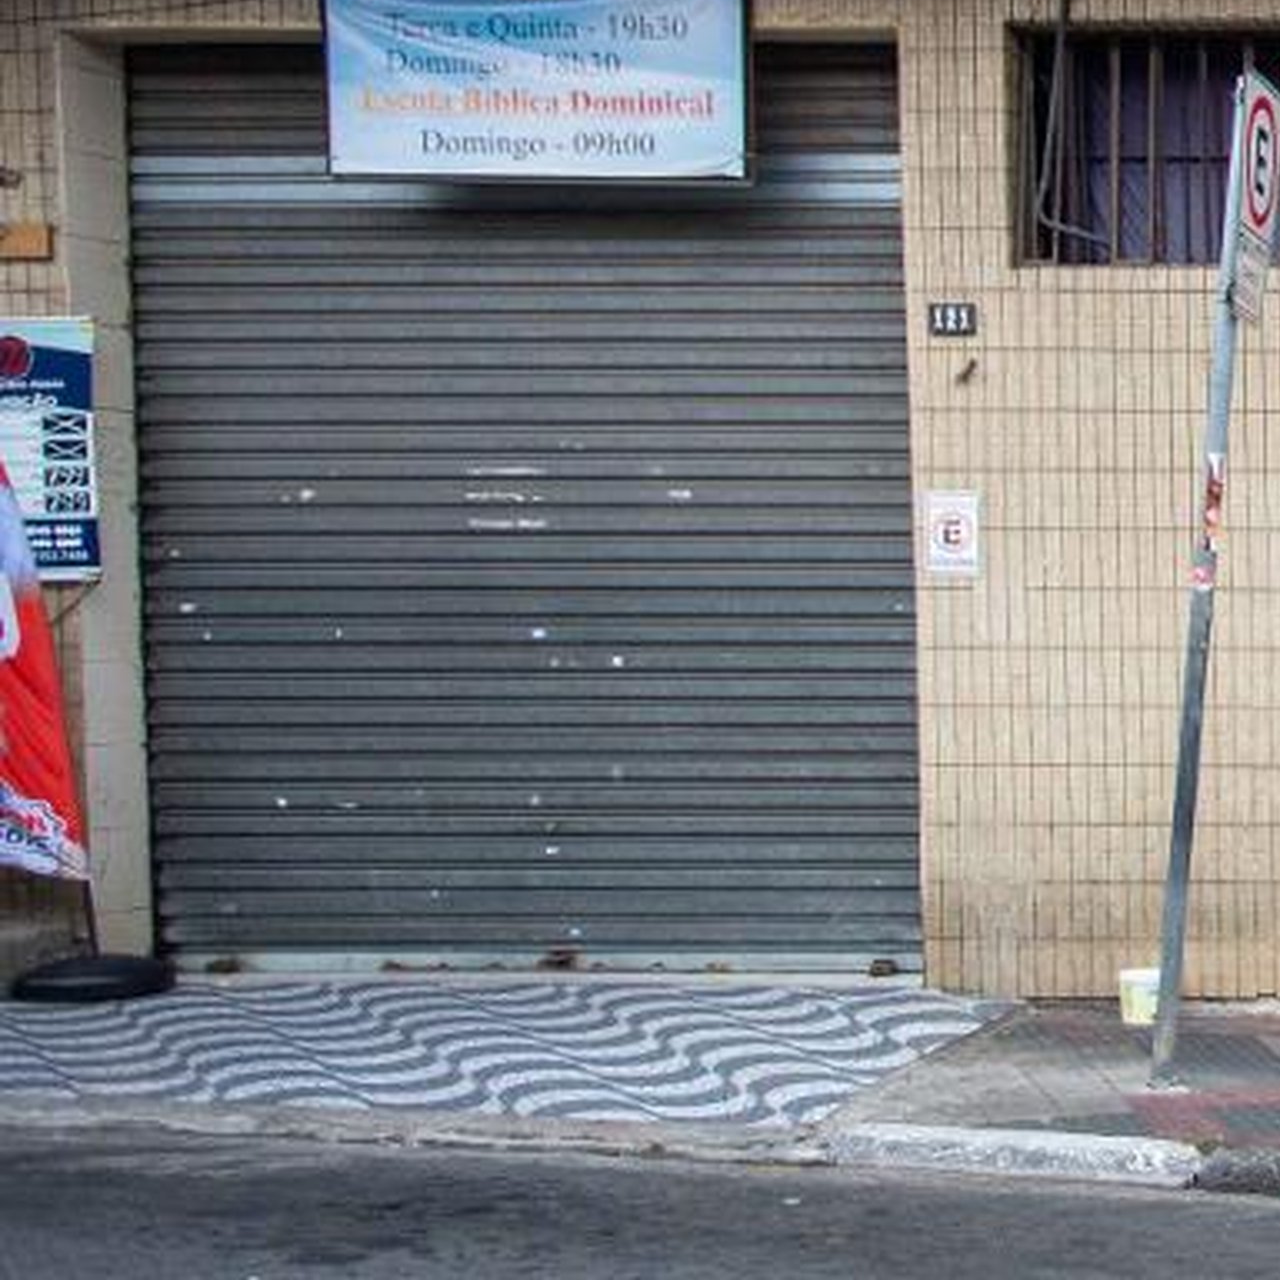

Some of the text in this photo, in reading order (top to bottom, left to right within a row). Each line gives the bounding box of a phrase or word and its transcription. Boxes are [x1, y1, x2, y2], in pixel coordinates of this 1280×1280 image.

[486, 13, 579, 42] Quinta
[608, 14, 689, 40] 19h30
[386, 49, 506, 80] Domingo
[570, 89, 714, 116] Dominical
[421, 129, 547, 160] Domingo
[574, 132, 655, 156] 09h00
